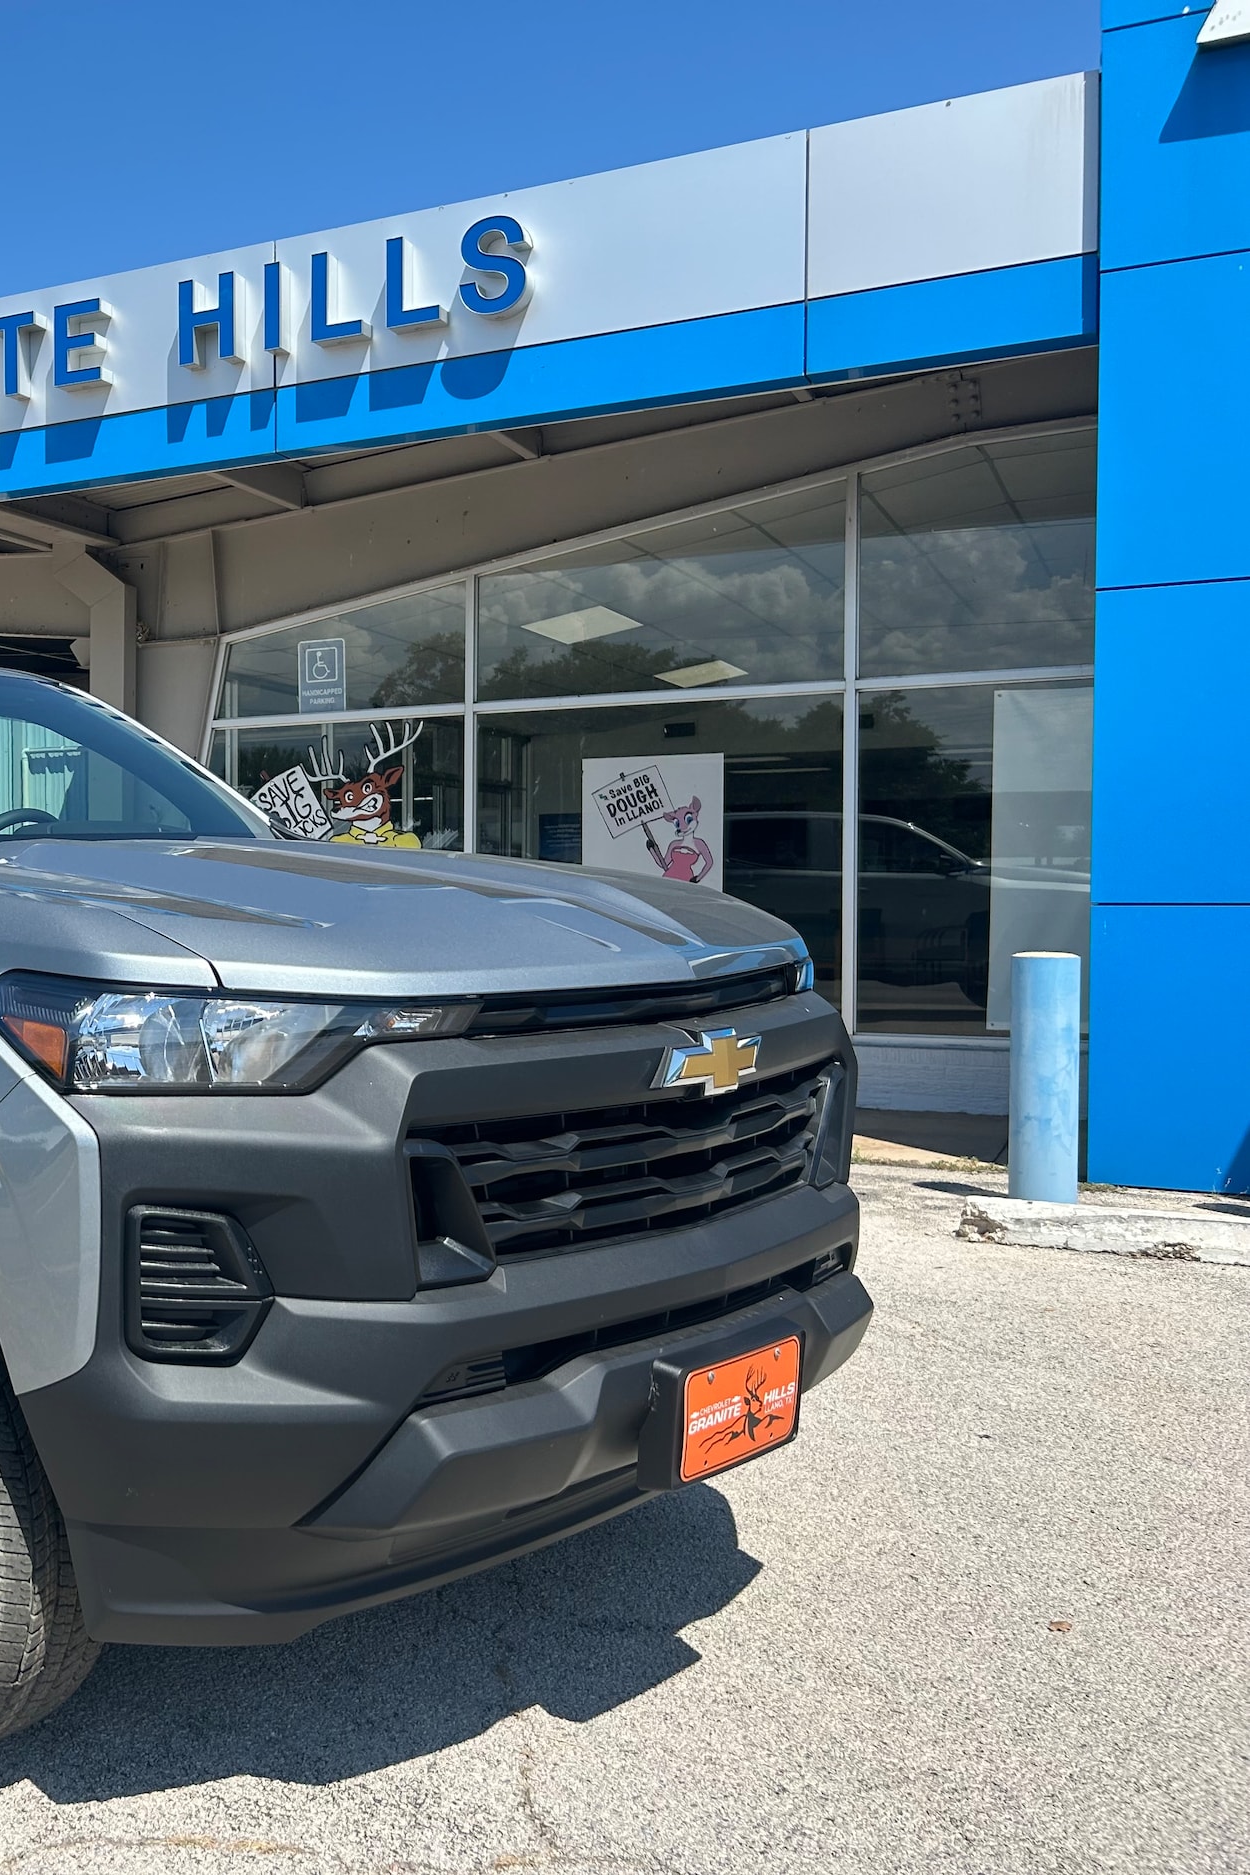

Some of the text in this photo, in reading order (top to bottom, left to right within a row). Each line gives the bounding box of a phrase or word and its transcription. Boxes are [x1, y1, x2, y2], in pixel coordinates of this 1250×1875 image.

[178, 215, 529, 368] HILLS
[301, 687, 343, 697] HANDICAPPED
[309, 697, 335, 705] PARKING
[258, 770, 305, 811] SAVE
[608, 774, 650, 799] Save BIG
[606, 783, 659, 818] DOUGH
[625, 797, 664, 822] LLANO!
[688, 1381, 795, 1435] GRANITE HILLS
[699, 1398, 732, 1415] CHEVROLET
[785, 1395, 793, 1405] TX
